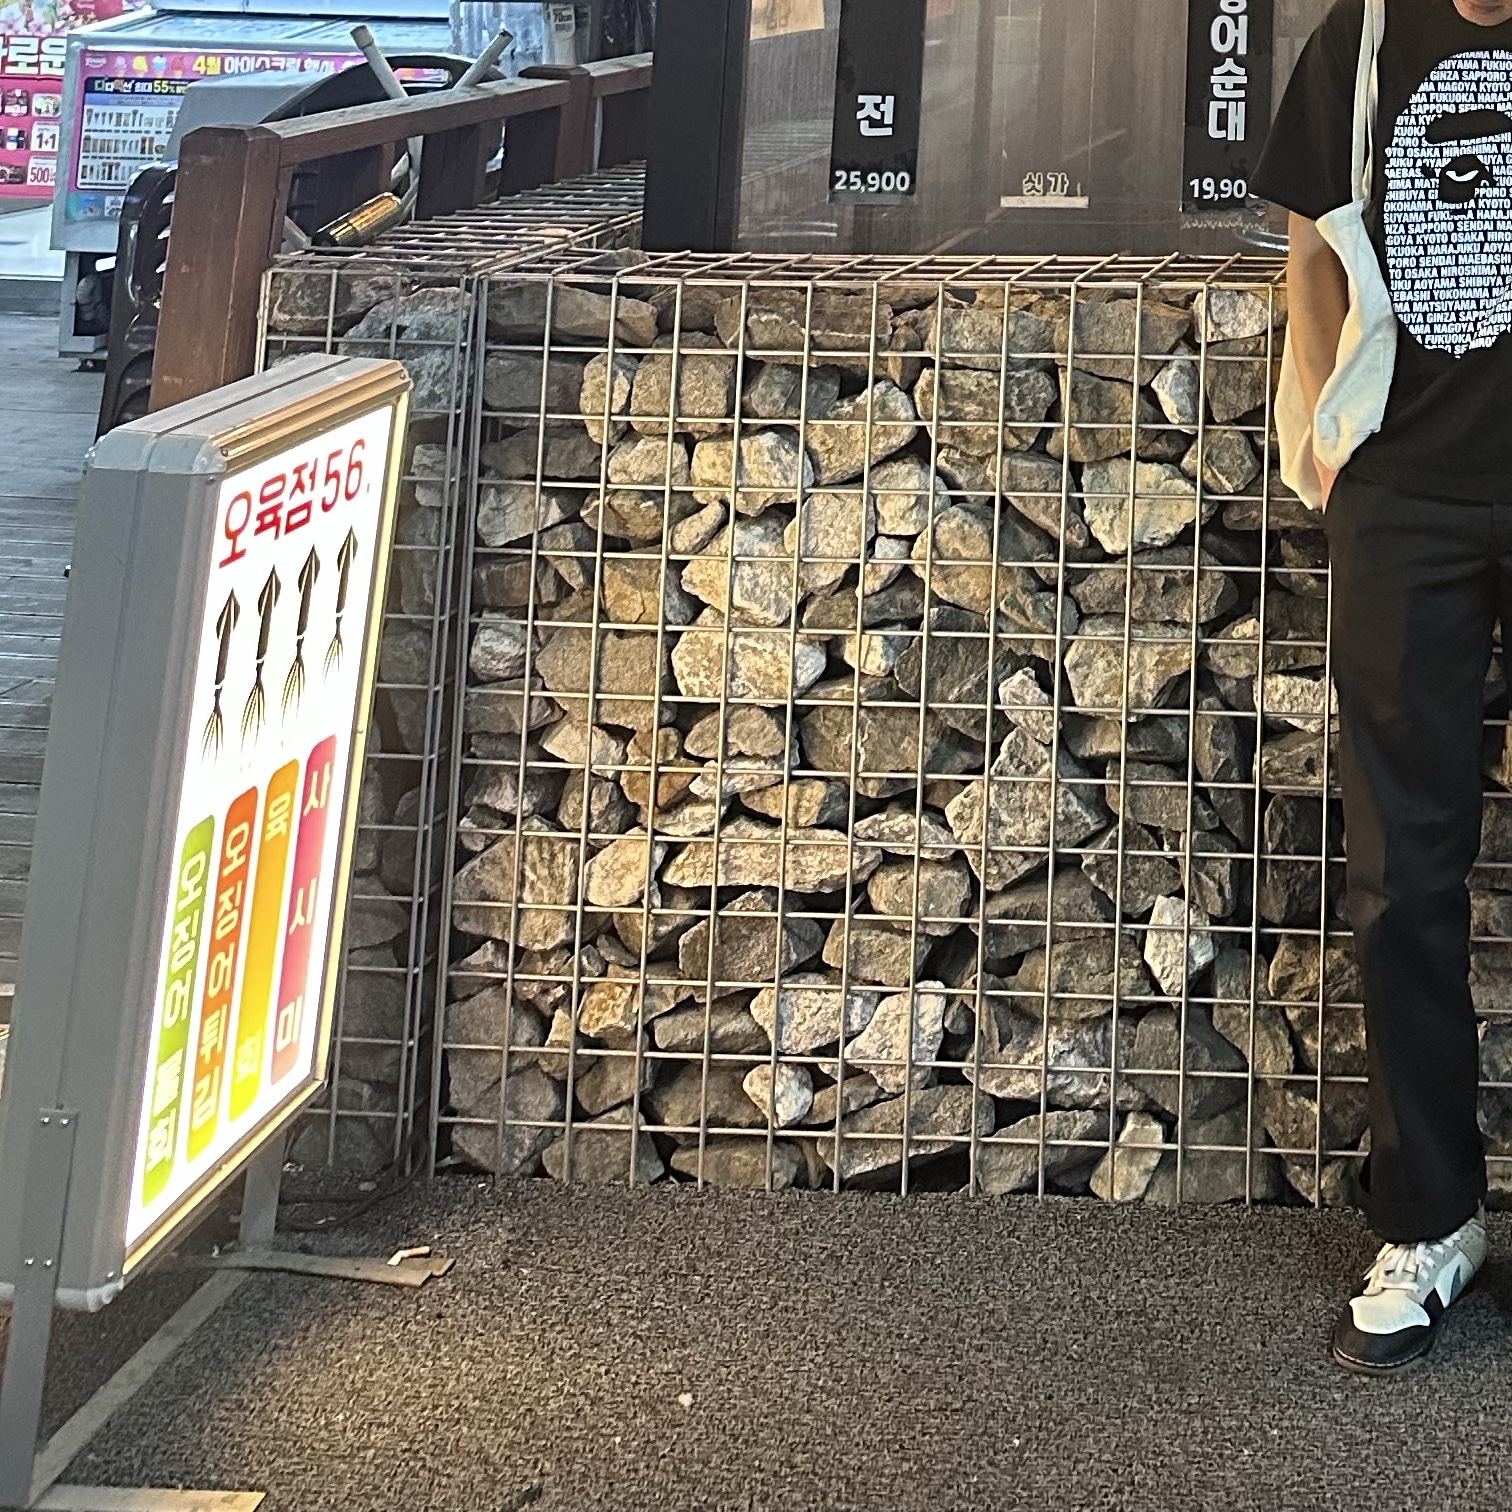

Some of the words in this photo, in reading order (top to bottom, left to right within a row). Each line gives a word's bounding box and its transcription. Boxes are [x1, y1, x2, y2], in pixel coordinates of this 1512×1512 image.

[1430, 71, 1459, 81] GINZA
[1462, 71, 1506, 81] SAPPORO
[1438, 82, 1477, 92] NAGOYA
[1479, 81, 1510, 93] KYOTO
[1430, 92, 1475, 103] FUKUOKA
[1411, 104, 1456, 114] SAPPORO
[1407, 147, 1440, 157] OSAKA
[1443, 144, 1498, 157] HIROSHIMA
[834, 169, 910, 193] 25,900
[1189, 178, 1258, 201] 19,90
[1478, 198, 1510, 209] KYOTO
[1384, 212, 1425, 224] SUYAMA
[1408, 222, 1454, 234] SAPPORO
[1457, 221, 1494, 232] SENDAI
[1416, 233, 1448, 244] KYOTO
[1451, 232, 1484, 243] OSAKA
[1427, 243, 1480, 255] HARAJUKU
[1419, 256, 1455, 267] SENDAI
[1458, 254, 1511, 265] MAEBASHI
[1405, 267, 1438, 279] OSAKA
[1441, 266, 1497, 278] HIROSHIMA
[1414, 278, 1456, 290] AOYAMA
[1459, 276, 1503, 287] SHIBUYA
[1433, 289, 1489, 300] YOKOHAMA
[1413, 300, 1477, 312] MATSUYAMA
[1426, 311, 1456, 323] GINZA
[1434, 322, 1475, 334] NAGOYA
[1424, 334, 1472, 344] FUKUOKA
[219, 457, 319, 569] 오육점
